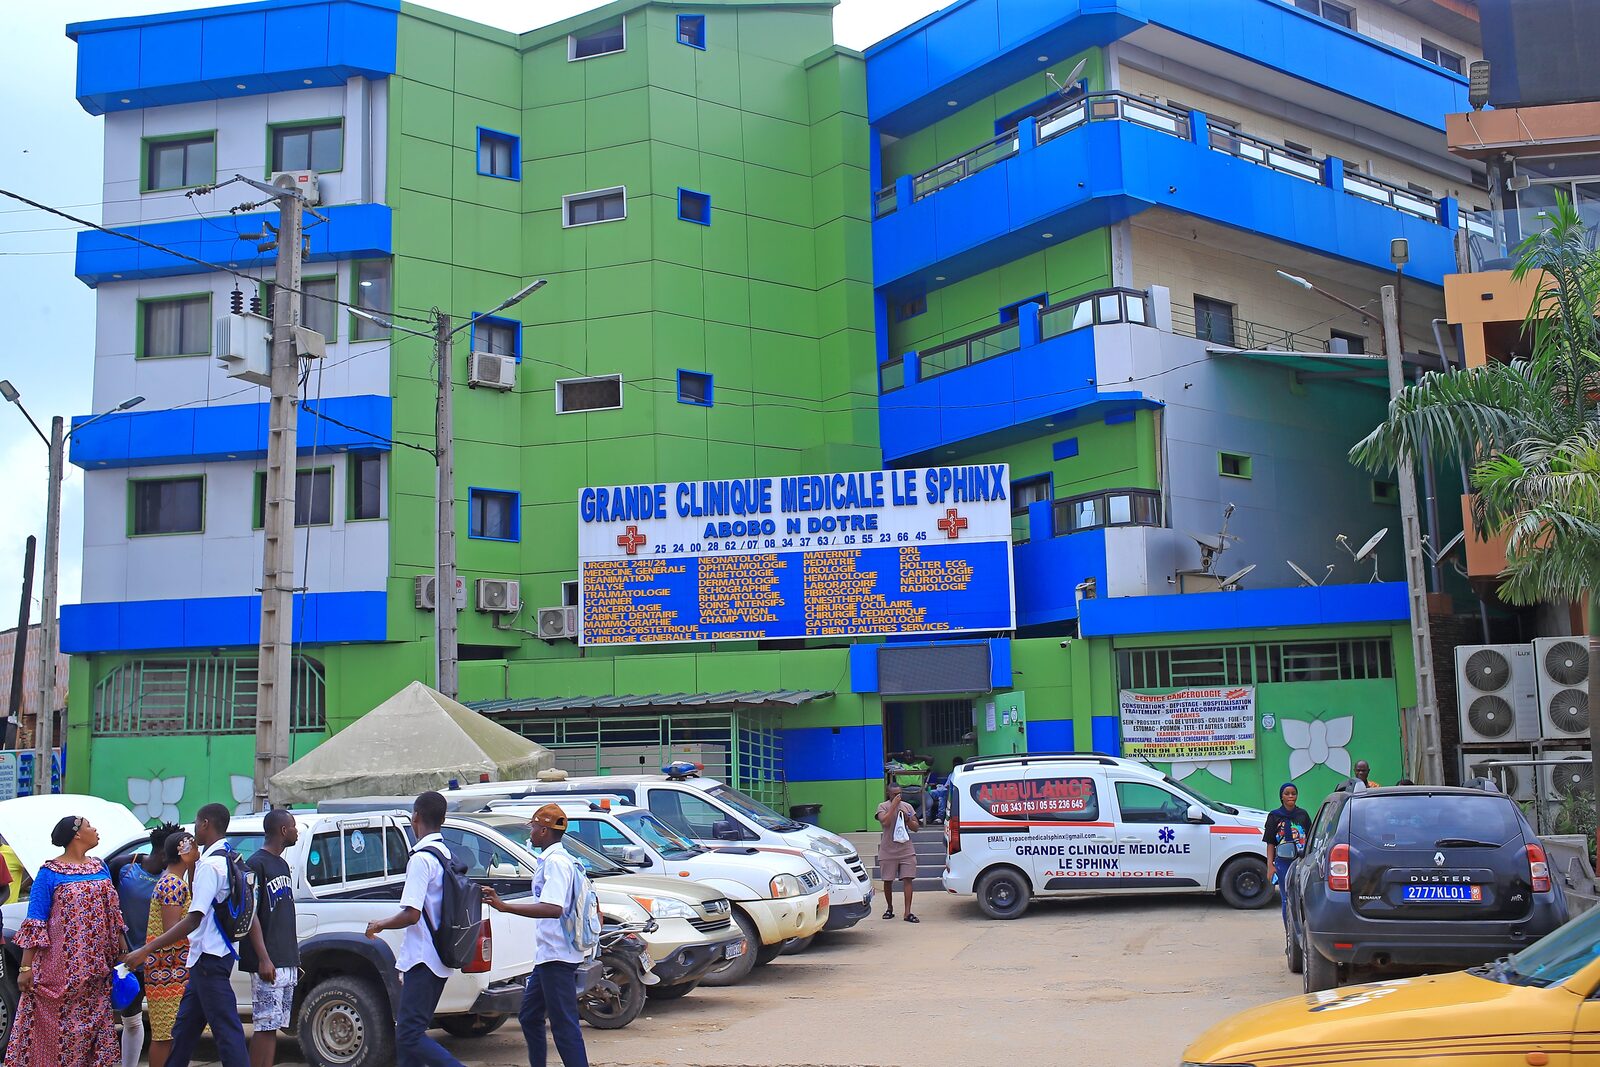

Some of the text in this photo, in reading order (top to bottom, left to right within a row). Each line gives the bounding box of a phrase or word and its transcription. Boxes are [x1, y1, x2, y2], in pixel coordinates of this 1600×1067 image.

[581, 464, 1006, 522] GRANDE CLINIQUE MEDICALE LE SPHINX
[704, 514, 878, 539] ABOBO N DOTRE
[655, 544, 666, 554] 25
[674, 544, 684, 553] 24
[690, 543, 702, 552] 00
[708, 542, 719, 551] 28
[725, 541, 736, 550] 62
[764, 539, 776, 548] 08
[782, 538, 794, 547] 34
[800, 538, 810, 546] 37
[844, 535, 856, 544] 05
[862, 534, 873, 544] 55
[880, 534, 891, 542] 23
[898, 532, 908, 542] 66
[915, 532, 927, 541] 45
[698, 554, 778, 564] NEONATOLOGIE
[804, 550, 862, 559] MATERNITE
[584, 560, 666, 570] URGENCE 24H/24
[698, 561, 787, 571] OPHTALMOLOGIE
[804, 558, 856, 566] PEDIATRIE
[900, 560, 966, 570] HOLTER ECG
[584, 566, 686, 576] MEDECINE GENERALE
[699, 569, 774, 579] DIABETOLOGIE
[804, 565, 856, 574] UROLOGIE
[900, 566, 974, 577] CARDIOLOGIE
[584, 574, 654, 584] REANIMATION
[699, 577, 780, 586] DERMATOLOGIE
[804, 572, 878, 582] HEMATOLOGIE
[900, 575, 972, 584] NEUROLOGIE
[584, 583, 624, 591] DIALYSE
[699, 584, 771, 594] ECHOGRAPHIE
[804, 580, 876, 590] LABORATOIRE
[900, 583, 966, 592] RADIOLOGIE
[584, 588, 670, 598] TRAUMATOLOGIE
[699, 592, 780, 602] RHUMATOLOGIE
[804, 588, 871, 596] FIBROSCOPIE
[585, 598, 632, 606] SCANNER
[699, 599, 785, 609] SOINS INTENSIFS
[804, 594, 885, 604] KINESITHERAPIE
[584, 604, 662, 613] CANCEROLOGIE
[804, 600, 912, 612] CHIRURGIE OCULAIRE
[629, 610, 678, 619] DENTAIRE
[700, 608, 768, 616] VACCINATION
[804, 608, 927, 620] CHIRURGIE PEDIATRIQUE
[584, 618, 671, 628] MAMMOGRAPHIE
[700, 614, 779, 624] CHAMP VISUEL
[806, 615, 924, 627] GASTRO ENTEROLOGIE
[584, 625, 698, 636] GYNECO-OBSTETRIQUE
[822, 626, 844, 634] BIEN
[900, 622, 949, 632] SERVICES
[585, 635, 636, 644] CHIRURGIE
[640, 633, 692, 642] GENERALE
[712, 630, 766, 639] DIGESTIVE
[1167, 690, 1221, 700] CANCEROLOGIE
[979, 779, 1093, 800] AMBULANCE
[992, 799, 1084, 813] 07 08 343 763 05 55 236 645
[1016, 844, 1190, 856] GRANDE CLINIQUE MEDICALE
[1059, 858, 1119, 869] LE SPHINX
[1408, 886, 1464, 898] 2777KL01
